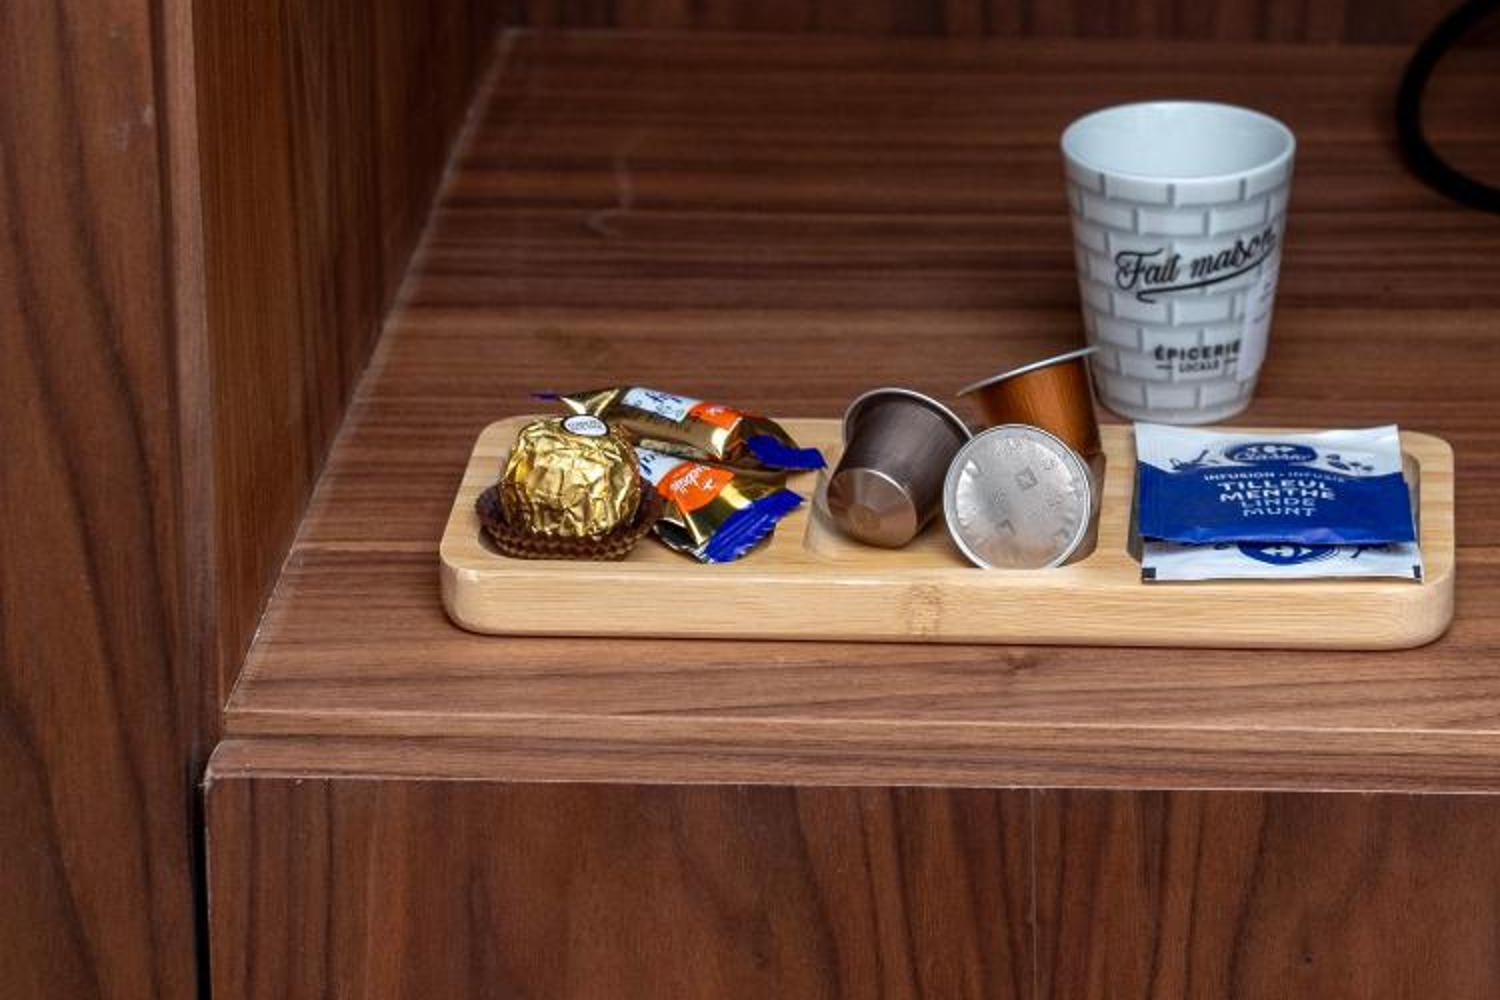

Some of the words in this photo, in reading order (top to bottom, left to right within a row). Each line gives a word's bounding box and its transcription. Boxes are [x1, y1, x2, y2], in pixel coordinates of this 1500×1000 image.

[1115, 248, 1181, 290] Fait
[1190, 227, 1277, 279] maison
[1203, 471, 1276, 481] INFUSION
[1217, 479, 1332, 491] TILLEUL
[1219, 487, 1336, 503] MENTHE
[1241, 498, 1316, 508] LINDE
[1243, 507, 1318, 517] MUNT
